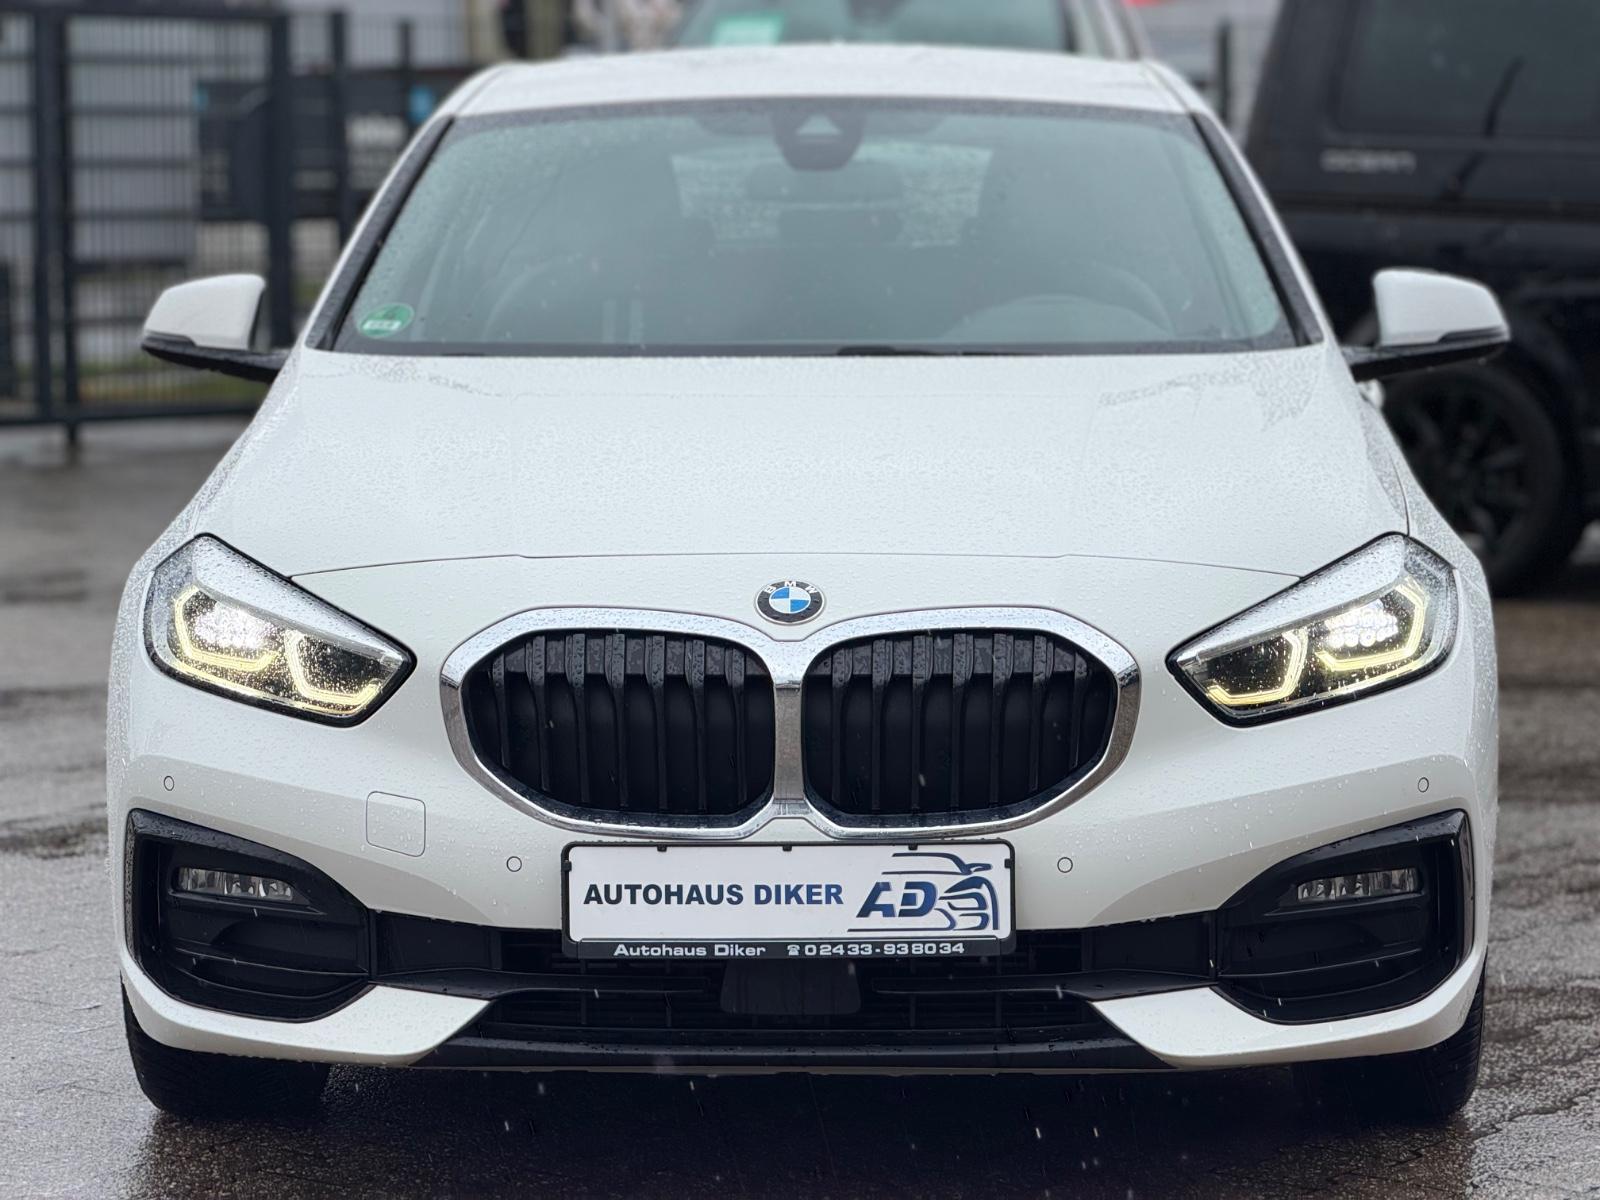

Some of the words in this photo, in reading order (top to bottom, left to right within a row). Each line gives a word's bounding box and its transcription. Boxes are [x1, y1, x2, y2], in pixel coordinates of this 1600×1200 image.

[764, 580, 818, 594] BMW
[583, 883, 744, 906] AUTOHAUS
[754, 883, 844, 906] DIKER
[856, 881, 938, 918] AD
[613, 943, 707, 957] Autohaus
[714, 943, 767, 957] Diker
[804, 942, 965, 956] 02433-938034
